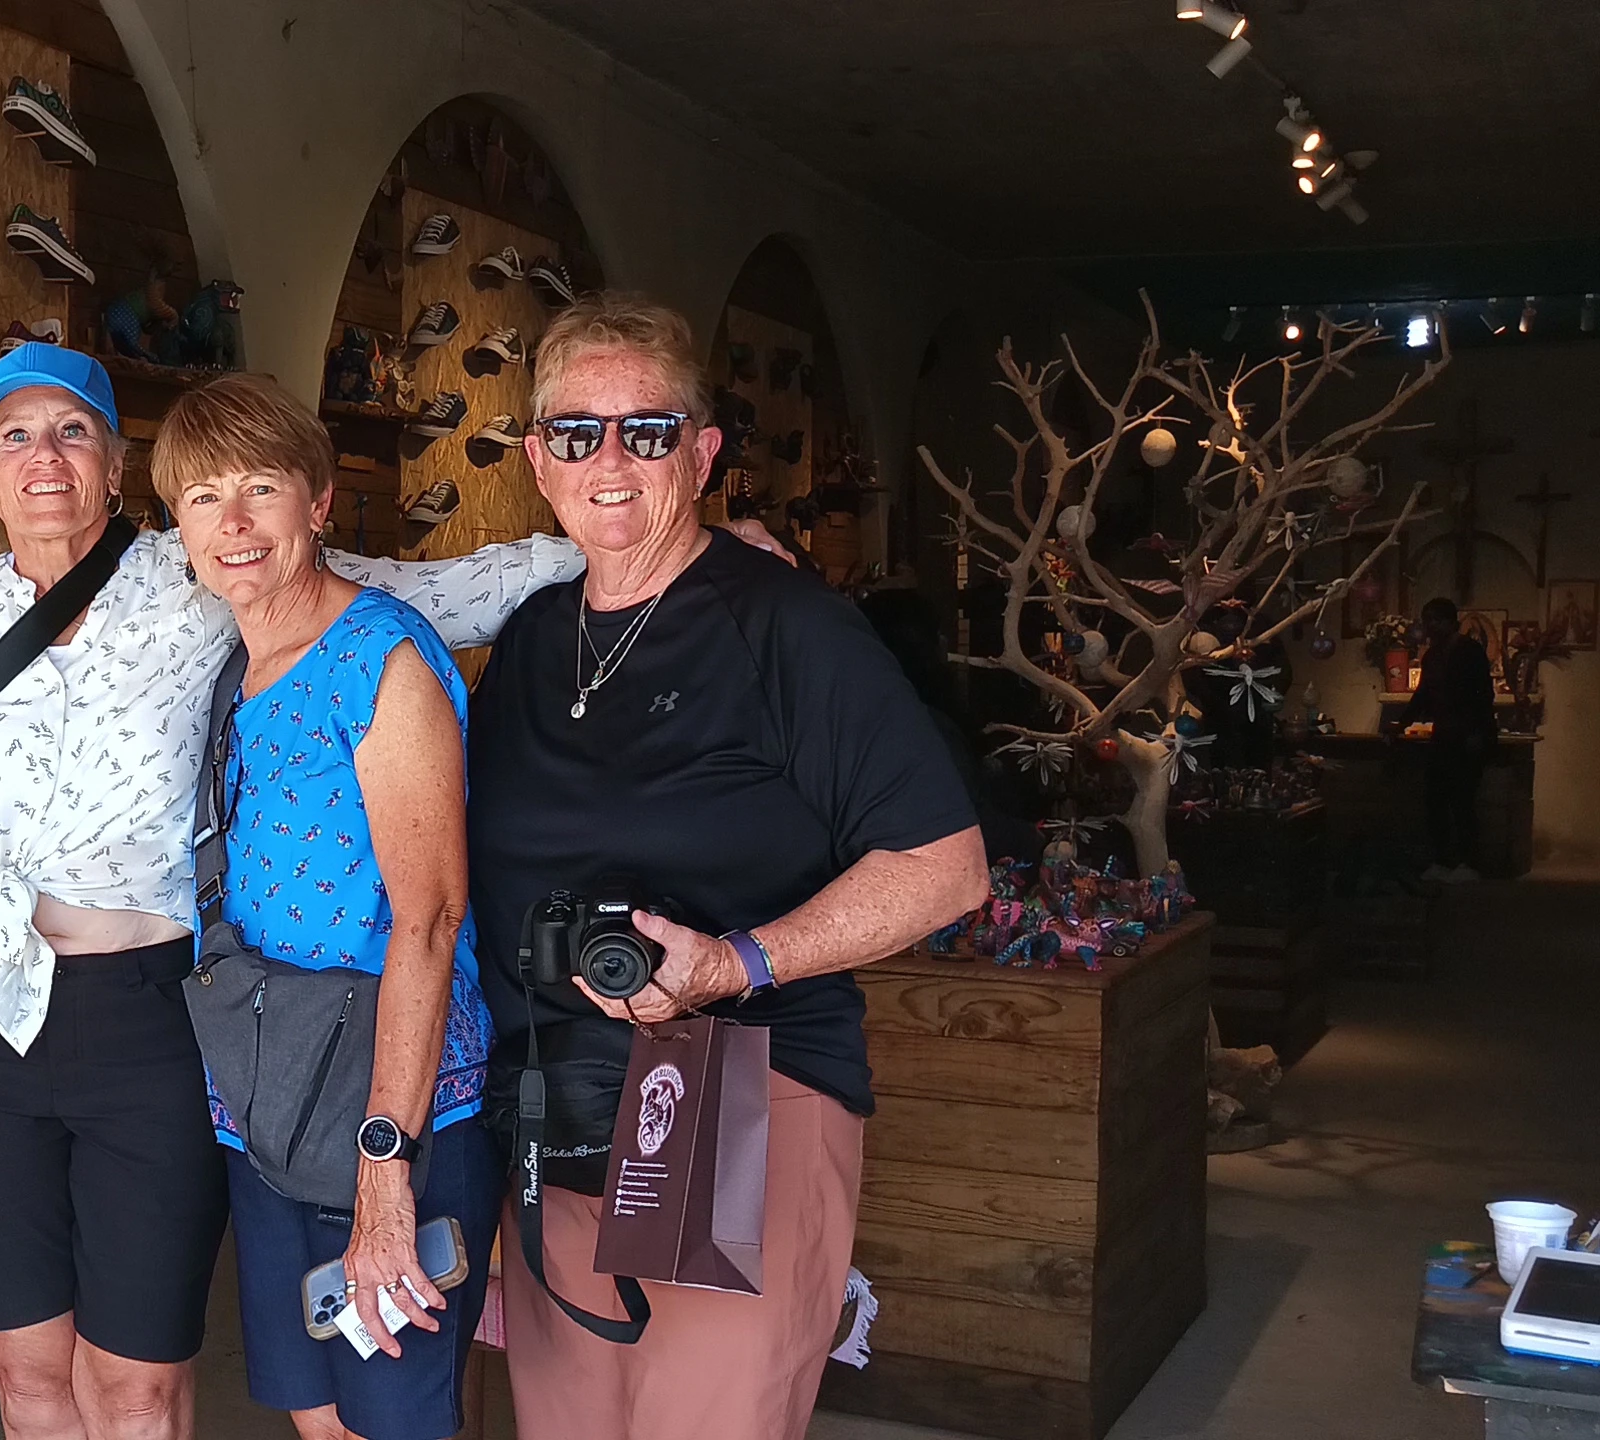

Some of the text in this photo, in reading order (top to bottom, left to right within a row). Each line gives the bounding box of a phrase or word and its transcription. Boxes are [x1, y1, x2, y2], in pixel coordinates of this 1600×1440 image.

[171, 660, 188, 676] love
[71, 736, 86, 759] love
[140, 749, 163, 766] love
[129, 810, 150, 825] love
[88, 846, 110, 860] love
[147, 853, 169, 867] love
[598, 904, 628, 913] Canon
[542, 1144, 612, 1158] Eddie Bauer
[523, 1141, 538, 1206] PowerShot
